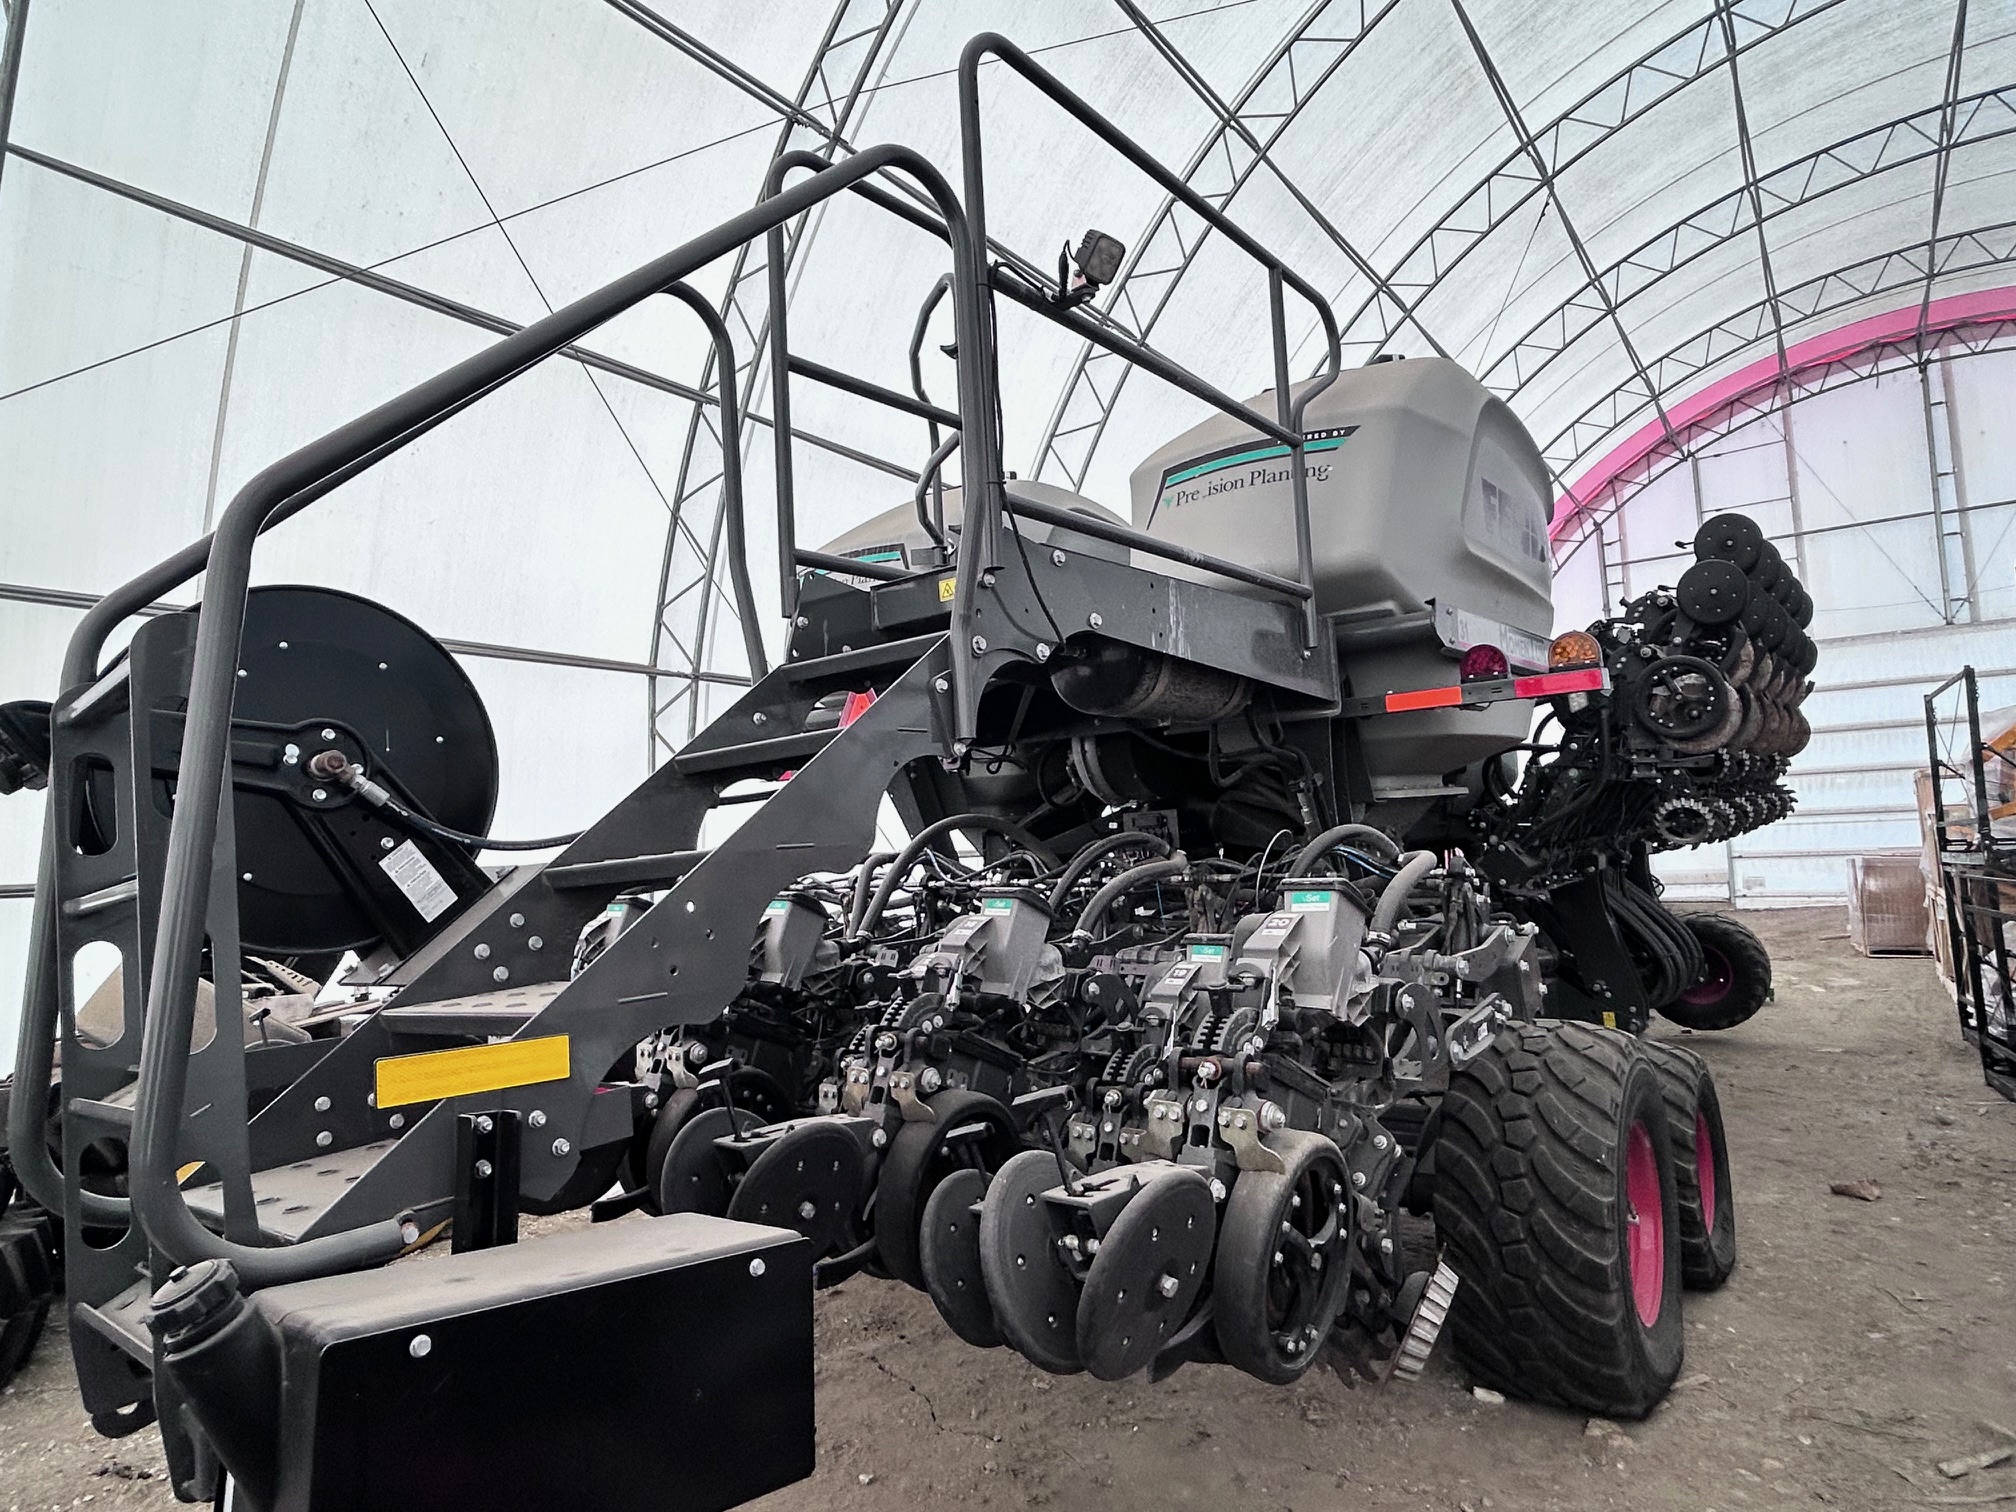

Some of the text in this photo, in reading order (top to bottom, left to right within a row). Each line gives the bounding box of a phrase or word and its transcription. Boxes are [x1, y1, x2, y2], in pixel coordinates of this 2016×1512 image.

[1332, 429, 1346, 437] BY
[1175, 477, 1244, 507] Preision
[1268, 918, 1290, 927] 20
